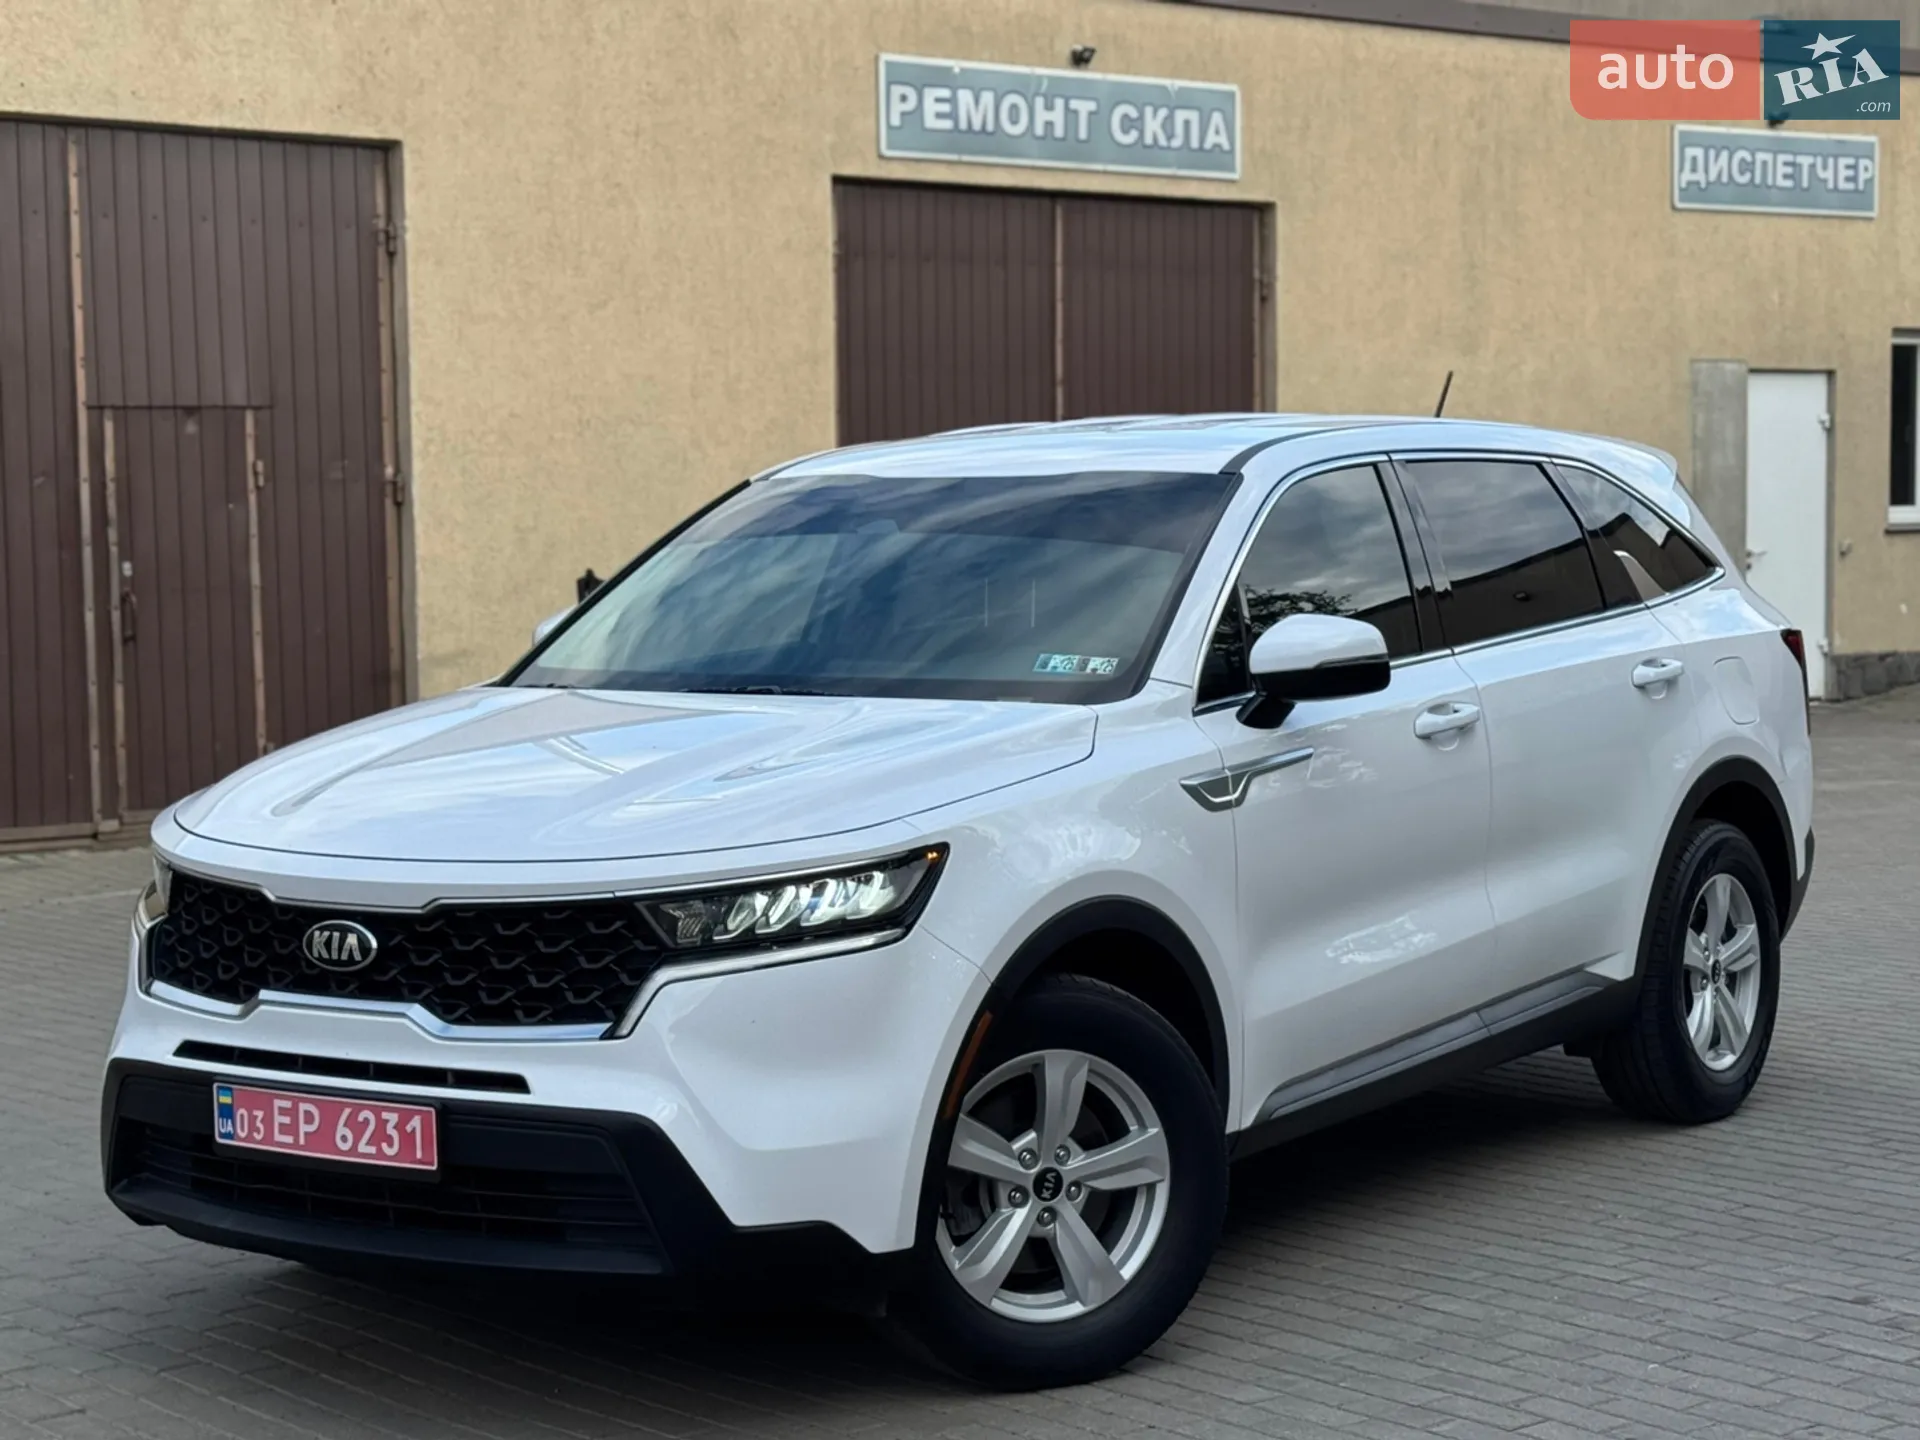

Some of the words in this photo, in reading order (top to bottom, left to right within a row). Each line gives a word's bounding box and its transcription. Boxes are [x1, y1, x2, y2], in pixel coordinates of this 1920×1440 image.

[888, 83, 1098, 141] РЕМОНТ
[1110, 104, 1231, 151] СКЛА
[1679, 146, 1874, 191] ДИСПЕТЧЕР
[312, 930, 362, 961] KIA
[219, 1117, 234, 1134] UA
[335, 1107, 423, 1159] 6231
